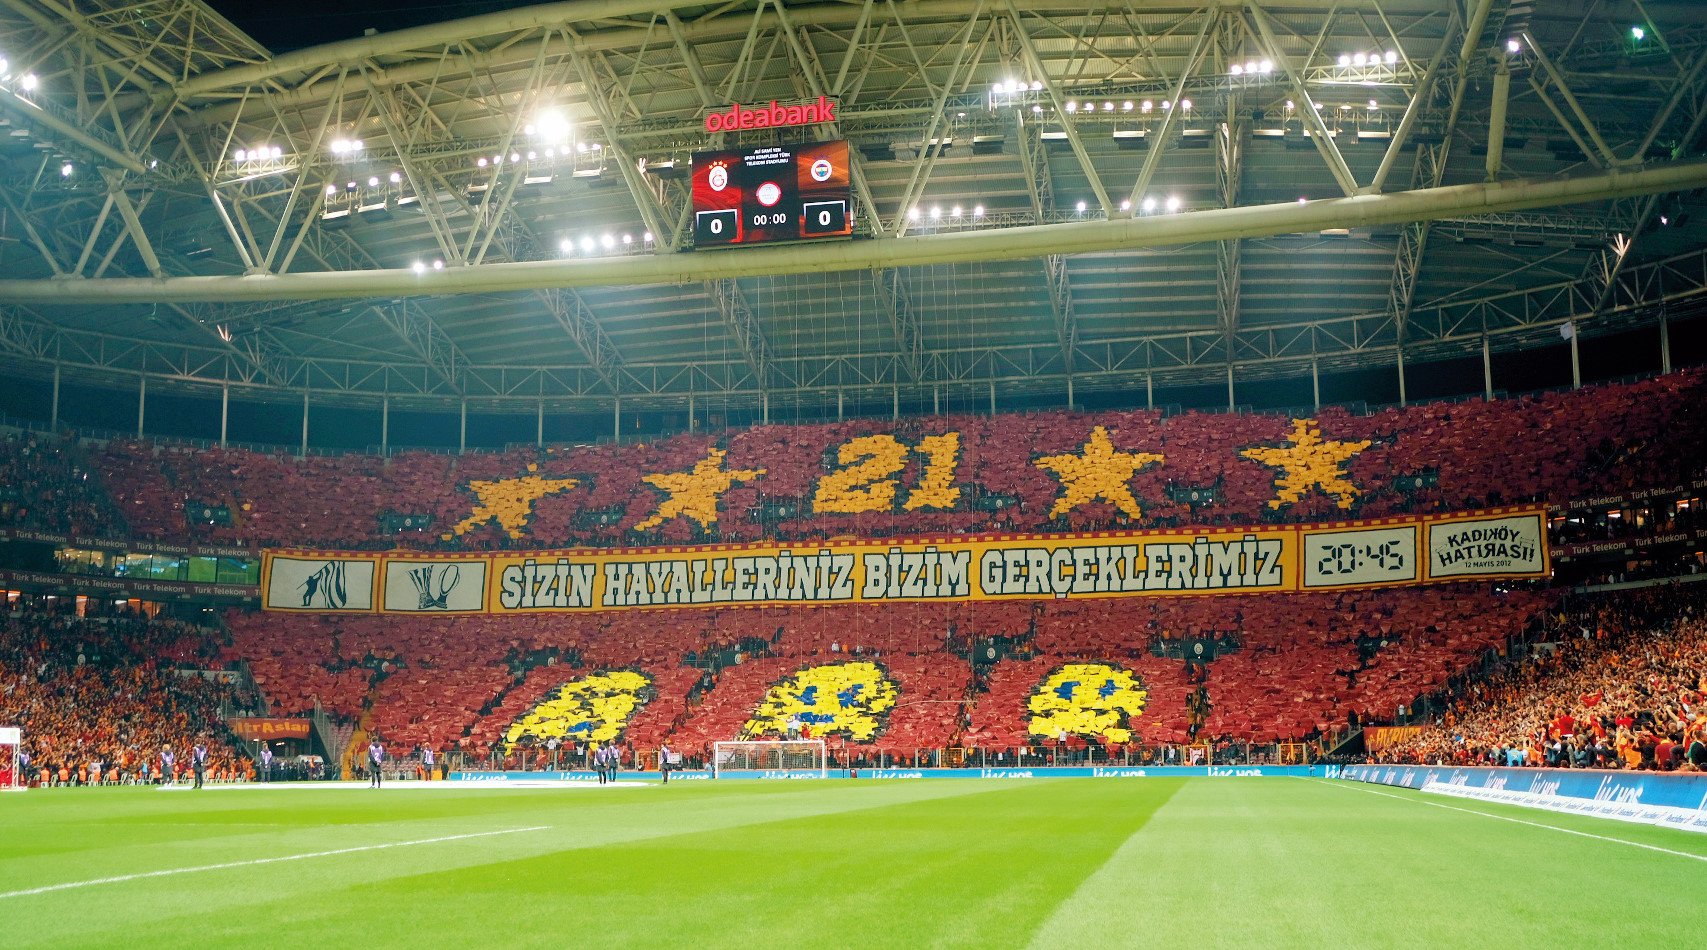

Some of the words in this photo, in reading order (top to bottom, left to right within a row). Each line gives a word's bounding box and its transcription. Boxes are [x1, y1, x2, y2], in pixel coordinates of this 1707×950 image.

[705, 95, 835, 132] odeabank
[710, 218, 723, 234] 0
[818, 210, 831, 226] 0
[812, 432, 961, 513] 21
[500, 558, 597, 609] SİZİN
[601, 550, 856, 607] HAYALLERİNİZ
[861, 546, 972, 600] BİZİM
[979, 534, 1284, 599] GERÇEKLERİMİZ
[1318, 540, 1404, 575] 20:45
